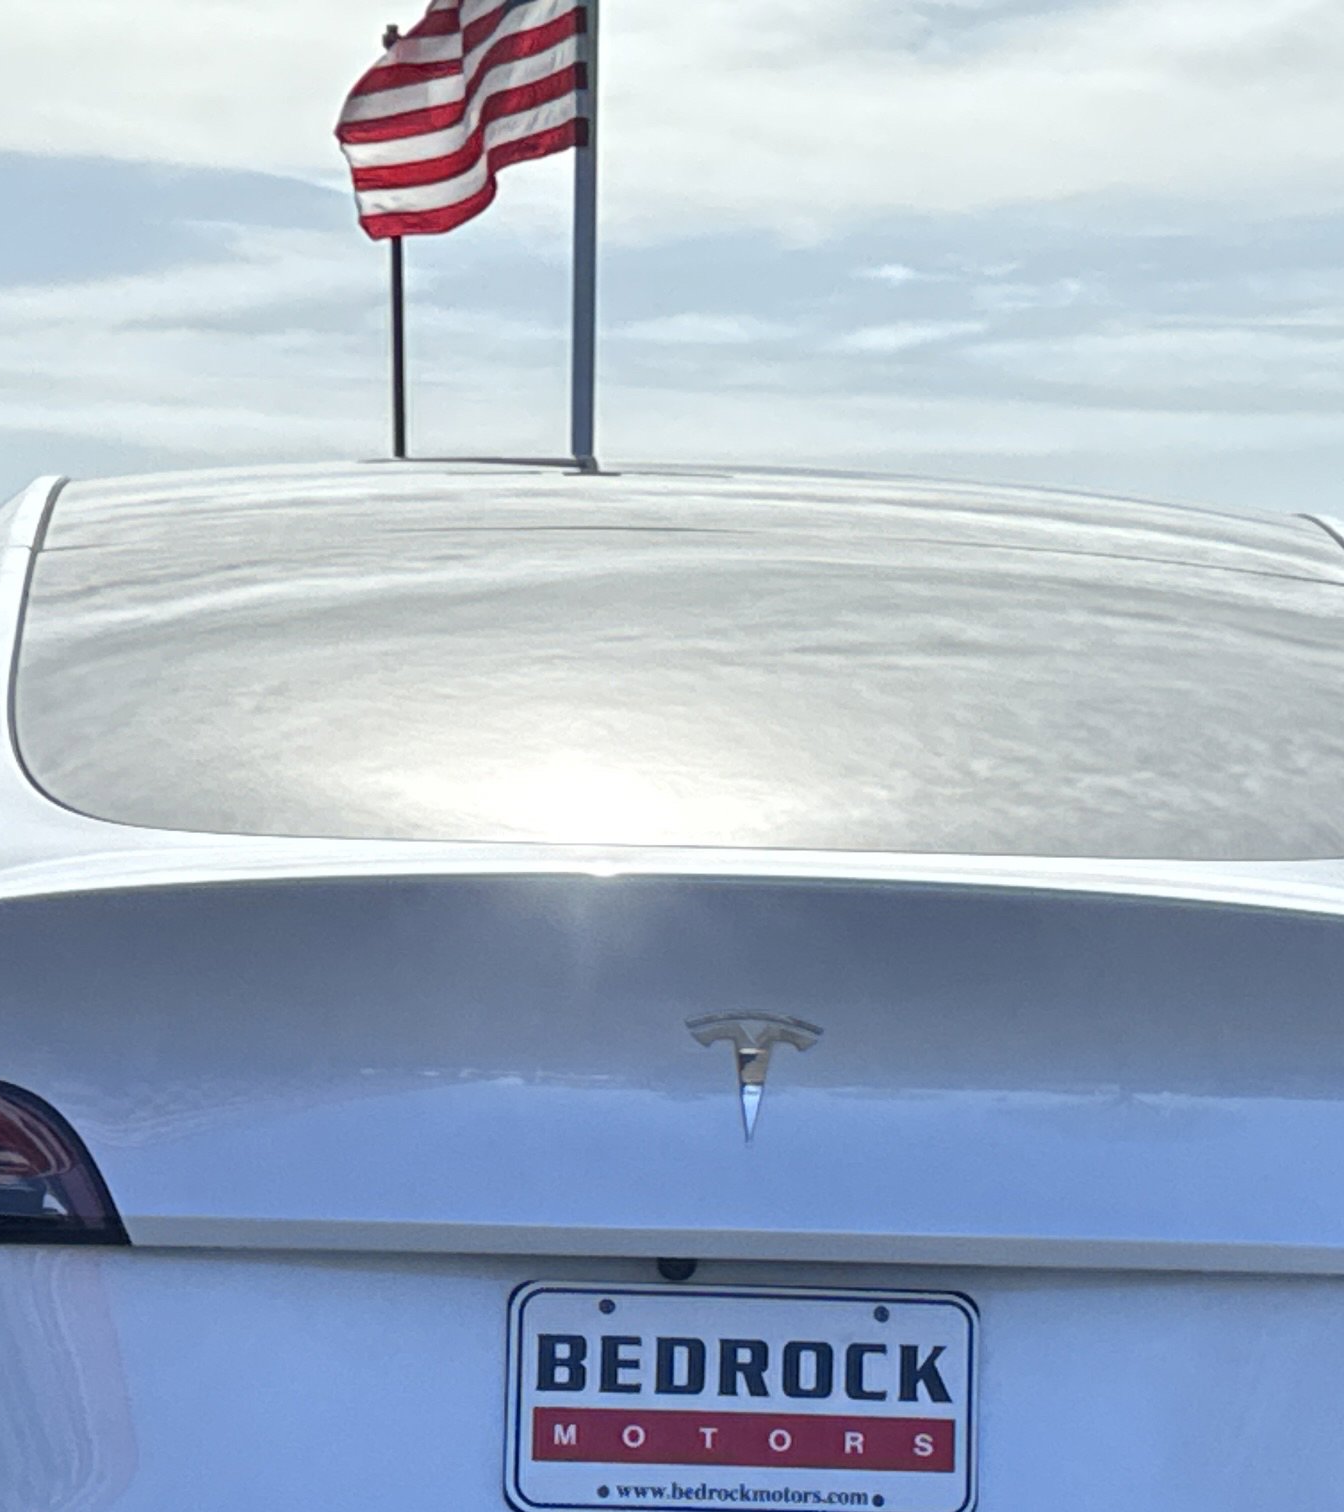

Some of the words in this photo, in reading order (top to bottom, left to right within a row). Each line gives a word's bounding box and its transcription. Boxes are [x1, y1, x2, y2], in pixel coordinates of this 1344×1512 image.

[535, 1332, 953, 1404] BEDROCK
[553, 1423, 934, 1456] MOTORS
[616, 1482, 869, 1507] www.bedrockmotors.com
